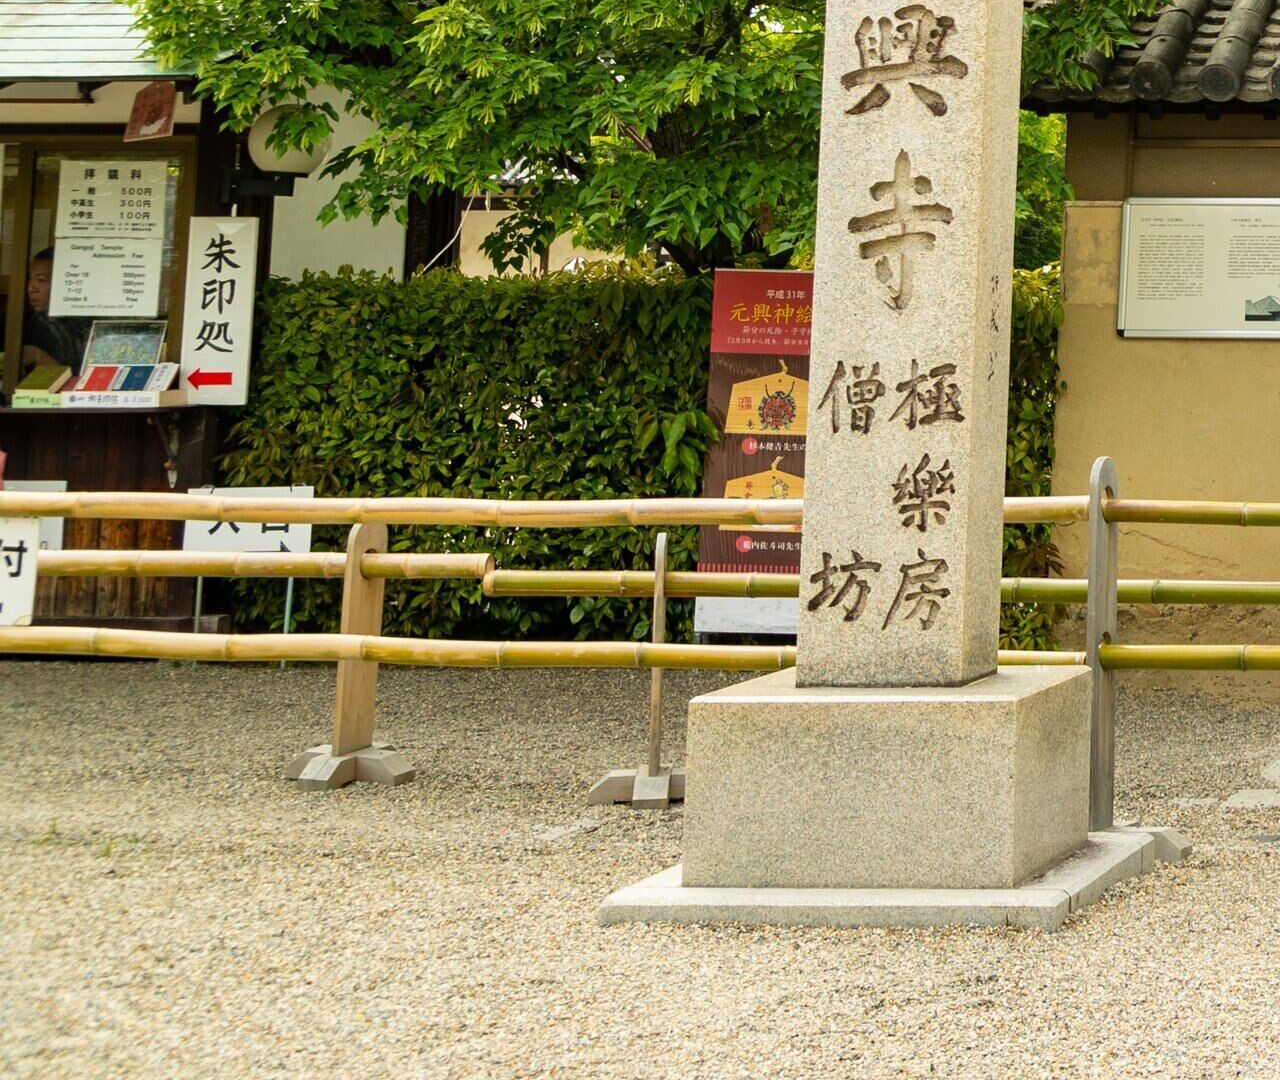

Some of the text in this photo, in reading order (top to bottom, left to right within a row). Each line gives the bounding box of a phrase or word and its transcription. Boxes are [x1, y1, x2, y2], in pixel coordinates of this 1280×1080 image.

[120, 187, 152, 196] 500円
[119, 199, 151, 208] 300円
[119, 211, 150, 220] 100円
[193, 232, 242, 353] 朱印処
[765, 289, 806, 300] 平成31年
[729, 302, 813, 325] 元興神絵
[807, 359, 886, 623] 僧坊
